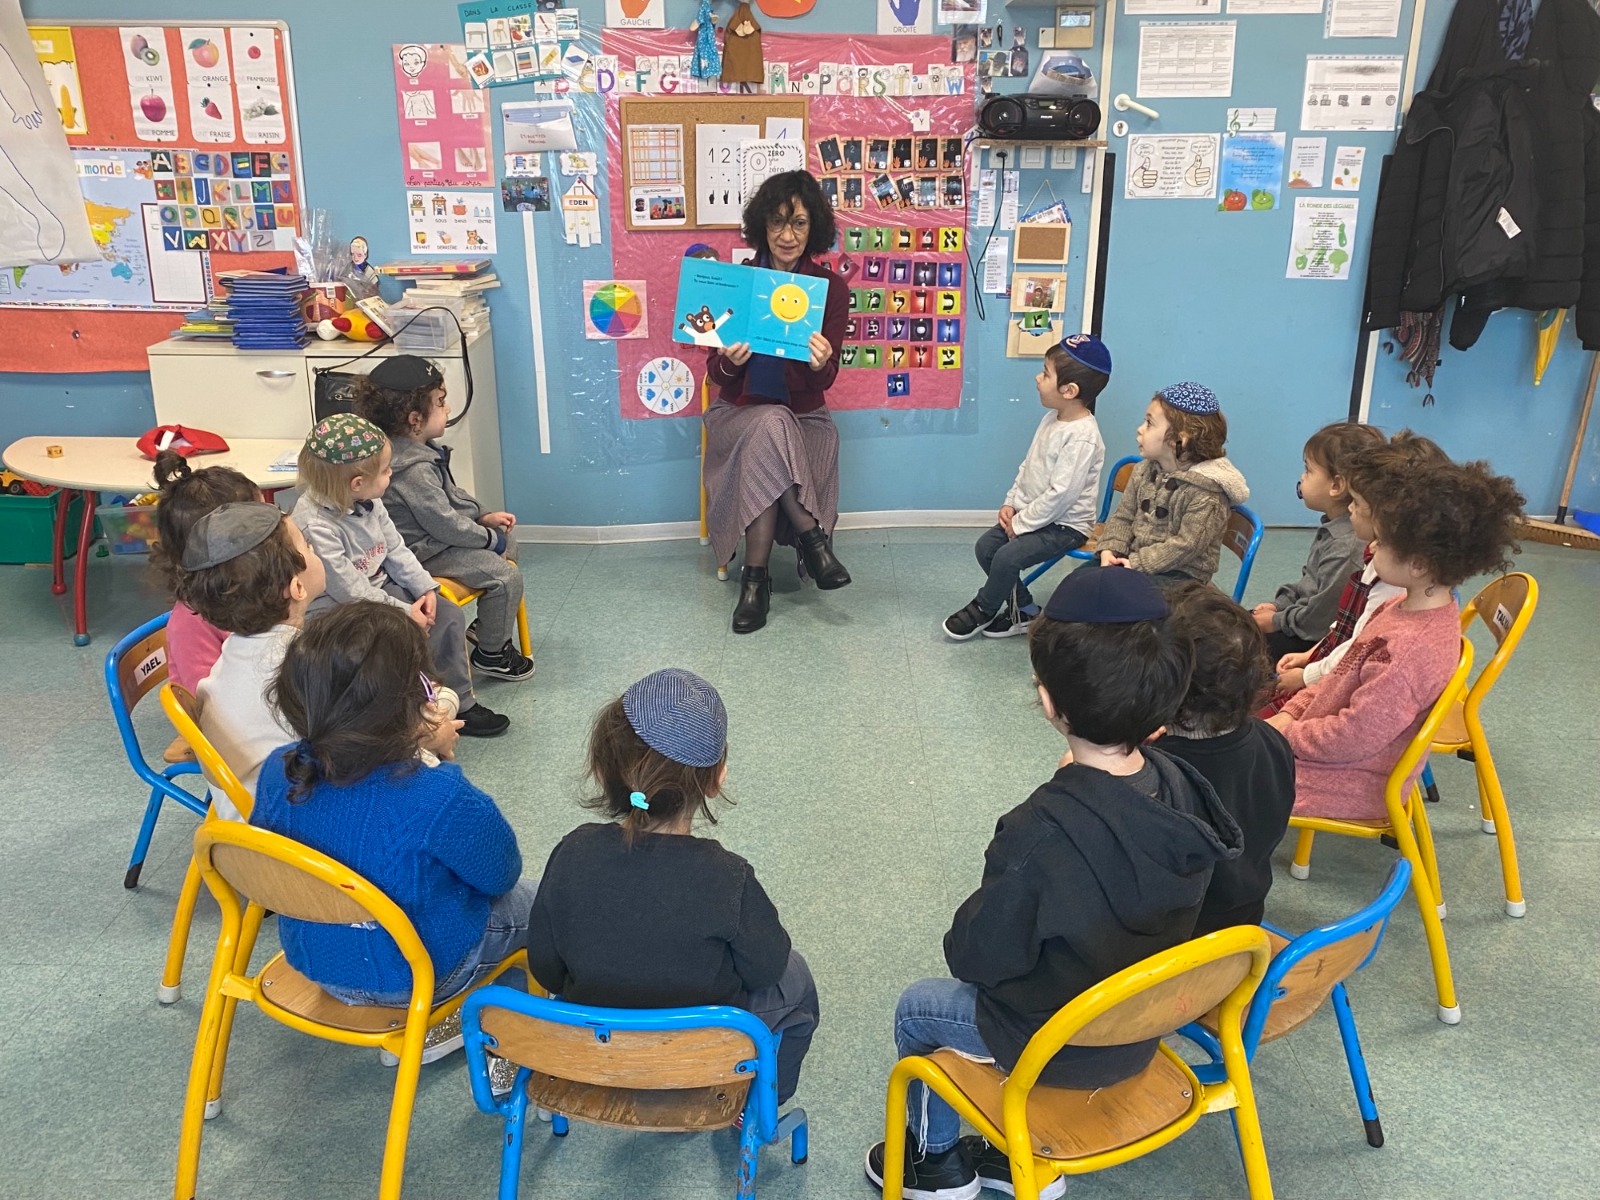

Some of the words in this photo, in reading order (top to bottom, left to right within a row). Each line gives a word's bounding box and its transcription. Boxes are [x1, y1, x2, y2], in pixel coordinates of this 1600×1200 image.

[508, 3, 532, 12] CLASSE
[620, 18, 652, 26] GAUCHE
[893, 26, 917, 34] DROITE
[598, 69, 615, 94] D
[636, 71, 651, 92] F
[660, 74, 680, 93] G
[771, 74, 786, 92] M
[791, 82, 800, 93] N
[820, 74, 832, 95] P
[858, 77, 870, 96] R
[872, 70, 887, 96] S
[896, 73, 909, 95] T
[946, 76, 963, 96] W
[152, 130, 176, 138] POMME
[258, 132, 281, 140] RAISIN
[154, 153, 172, 170] A
[174, 154, 191, 174] B
[214, 154, 230, 175] D
[232, 154, 250, 174] E
[254, 154, 270, 175] F
[271, 154, 288, 171] G
[708, 148, 714, 164] 1
[721, 147, 731, 164] 2
[84, 160, 122, 175] monde
[198, 180, 207, 203] J
[213, 181, 228, 201] K
[234, 184, 250, 201] L
[253, 182, 271, 202] M
[274, 183, 290, 202] N
[568, 198, 588, 206] EDEN
[160, 207, 178, 224] O
[184, 208, 197, 226] P
[202, 208, 220, 224] Q
[243, 206, 254, 229] S
[256, 208, 274, 226] T
[276, 208, 294, 224] U
[164, 230, 180, 248] V
[211, 232, 228, 250] X
[231, 231, 247, 251] Y
[254, 234, 272, 247] Z
[850, 230, 862, 249] ד
[874, 230, 884, 248] ג
[944, 230, 958, 248] א
[893, 264, 906, 280] ח
[892, 290, 905, 312] ל
[892, 347, 905, 368] ק
[140, 656, 162, 676] YAEL
